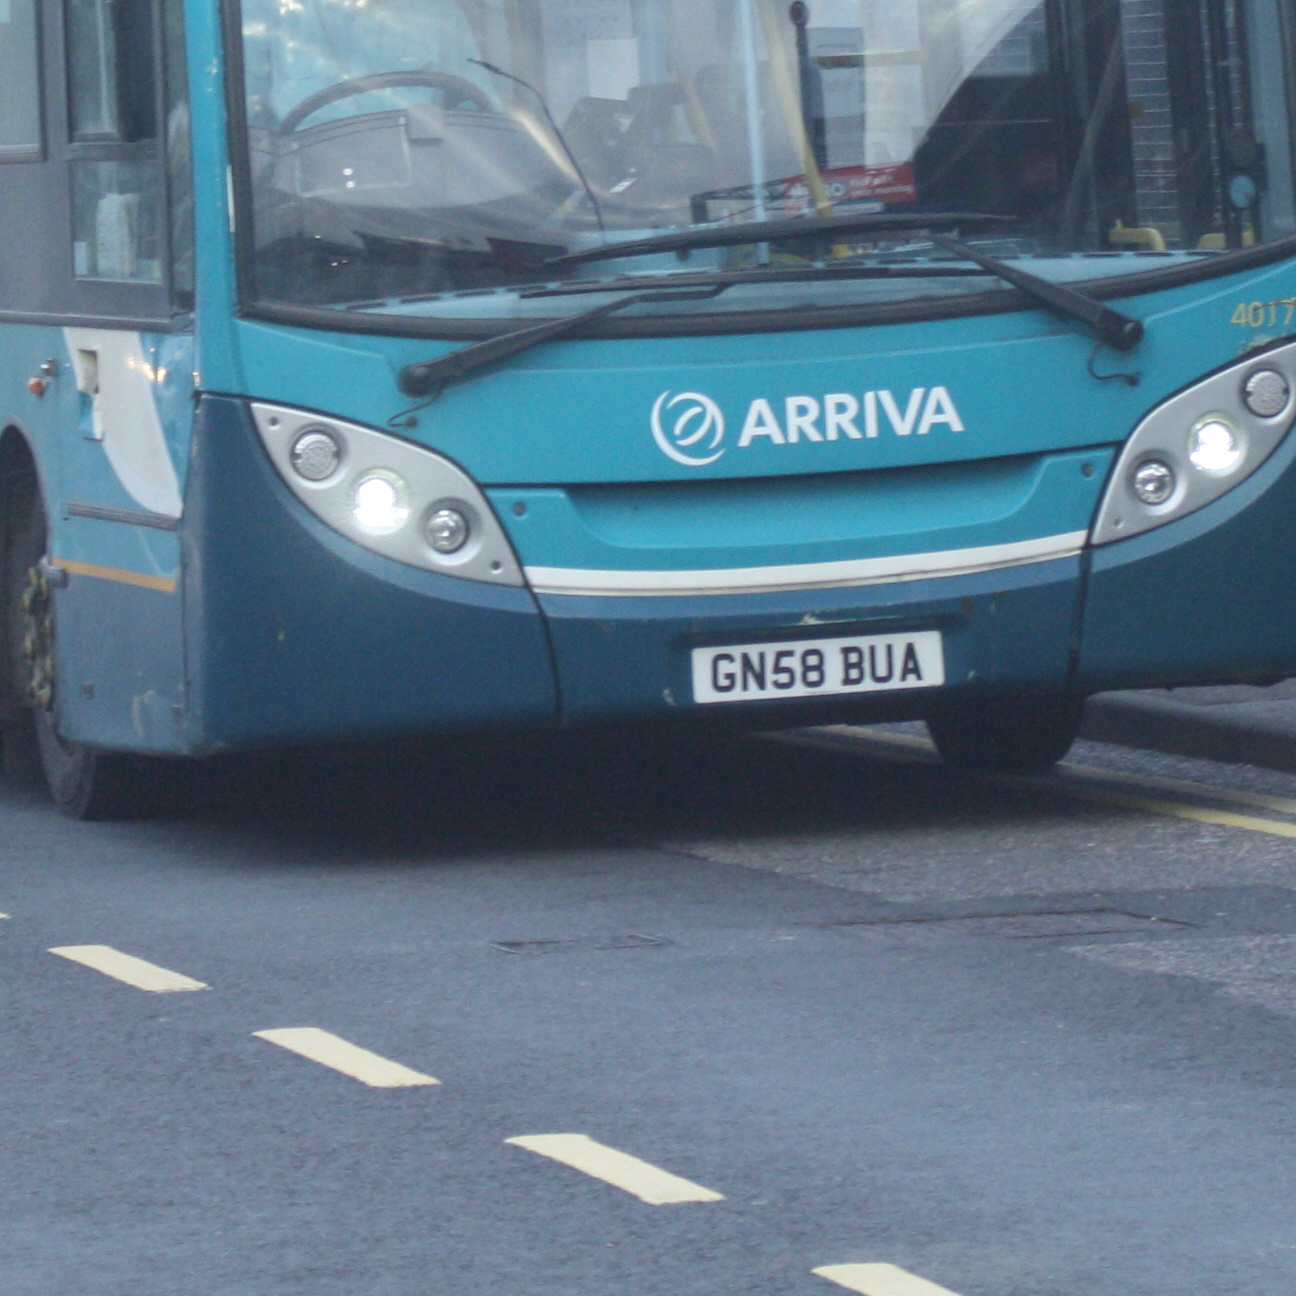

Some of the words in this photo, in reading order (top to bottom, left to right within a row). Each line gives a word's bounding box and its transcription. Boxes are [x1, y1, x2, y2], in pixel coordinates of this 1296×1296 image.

[737, 385, 965, 447] ARRIVA
[711, 648, 825, 694] GN58
[841, 641, 923, 687] BUA
